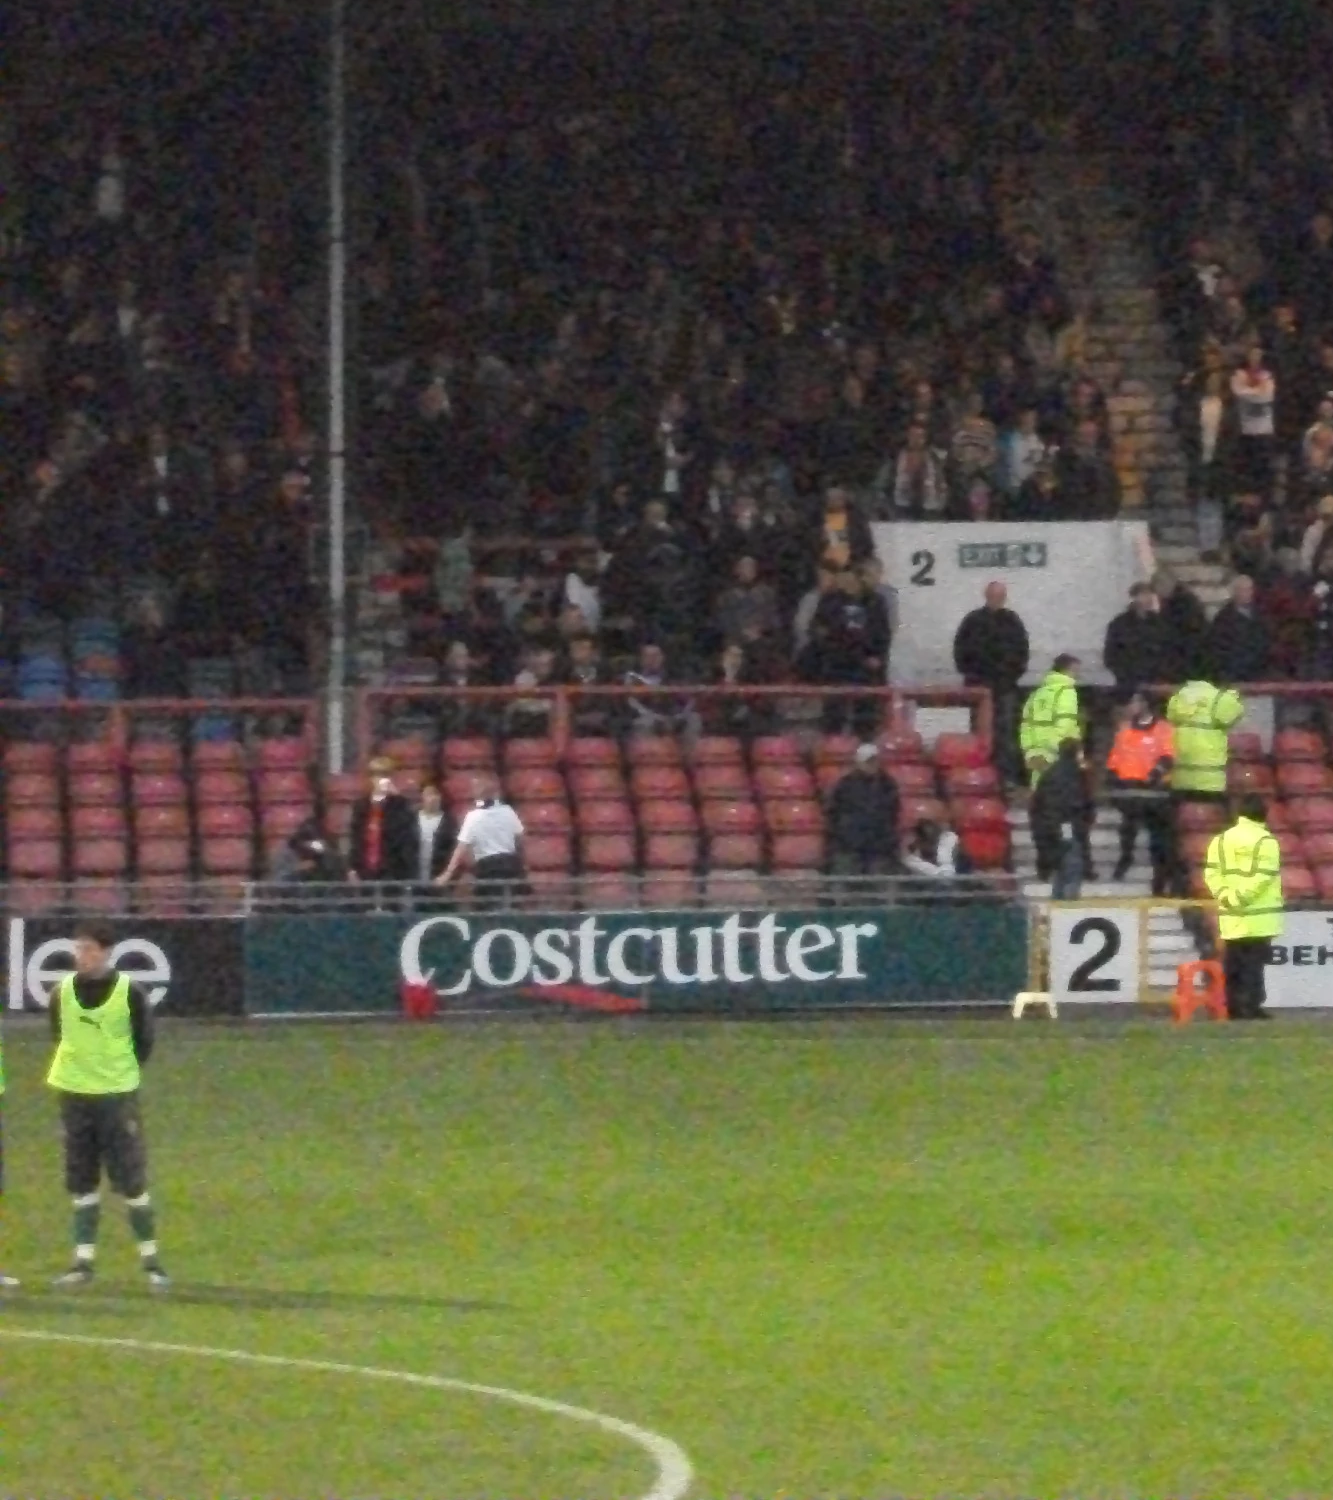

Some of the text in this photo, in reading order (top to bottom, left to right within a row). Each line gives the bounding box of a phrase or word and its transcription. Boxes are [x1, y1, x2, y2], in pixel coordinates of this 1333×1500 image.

[910, 550, 935, 586] 2
[400, 916, 878, 996] Costcutter
[1067, 917, 1122, 992] 2
